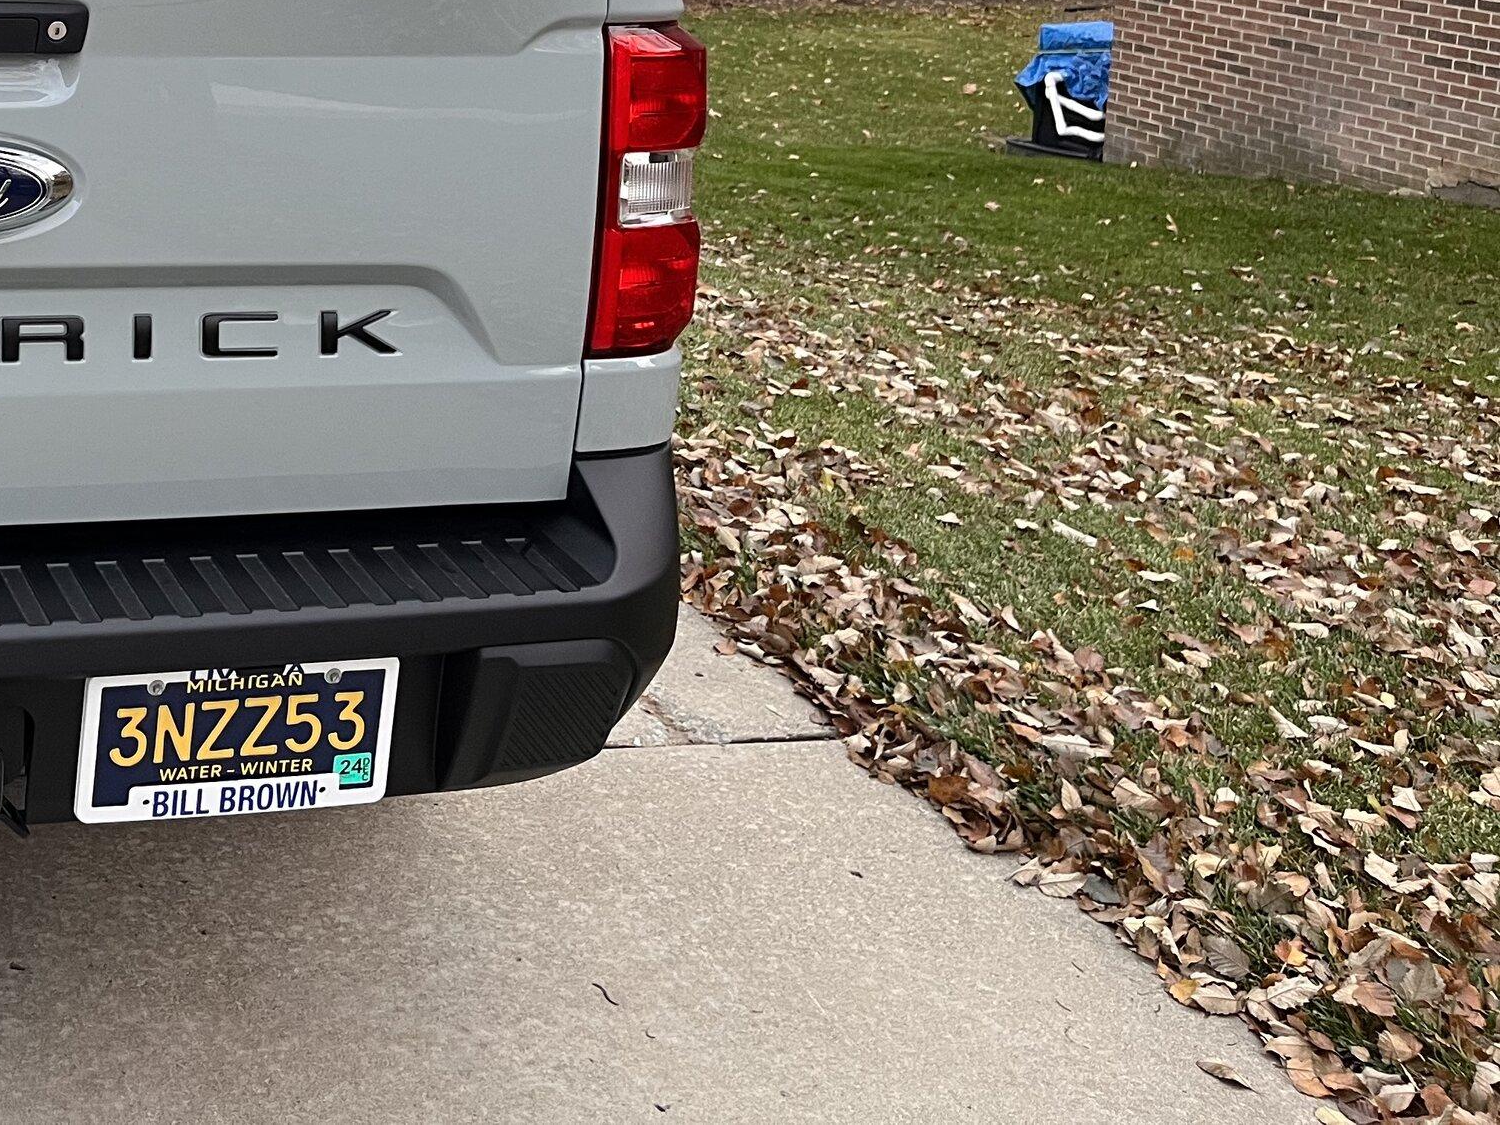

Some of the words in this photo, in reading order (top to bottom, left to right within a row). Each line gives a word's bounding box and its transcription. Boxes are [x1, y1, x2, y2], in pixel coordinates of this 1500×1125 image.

[186, 672, 303, 694] MICHIGAN
[109, 691, 365, 767] 3NZZ53
[159, 765, 222, 782] WATER
[240, 759, 313, 776] WINTER
[339, 758, 362, 775] 24
[152, 788, 210, 817] BILL
[220, 780, 318, 813] BROWN
